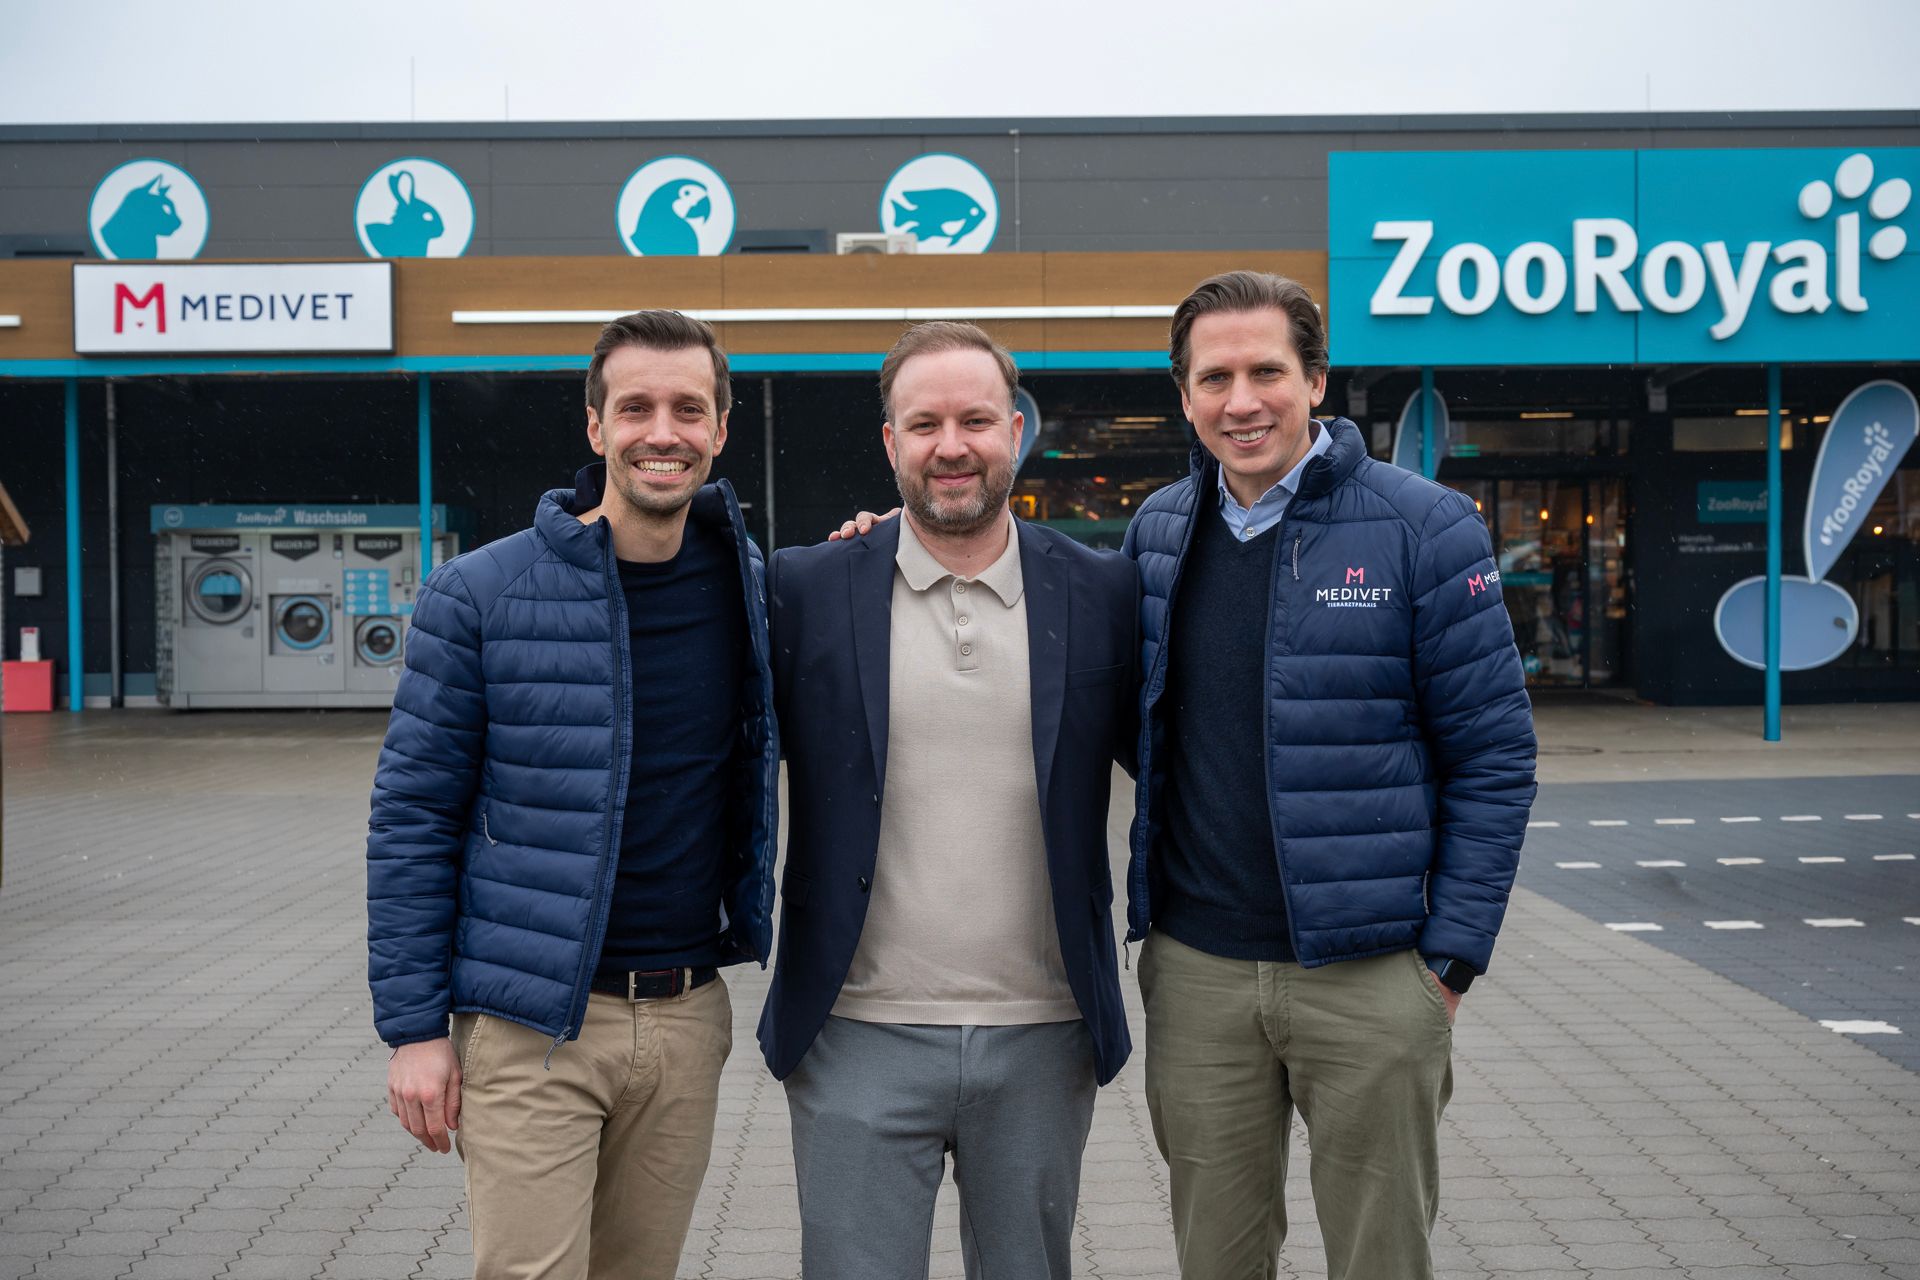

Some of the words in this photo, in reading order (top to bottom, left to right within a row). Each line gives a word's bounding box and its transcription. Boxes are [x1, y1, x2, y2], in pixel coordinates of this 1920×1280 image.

[1370, 211, 1869, 340] ZooRoyal
[115, 283, 166, 334] M
[181, 294, 353, 321] MEDIVET
[236, 510, 283, 526] ZooRoyal
[293, 509, 367, 524] Waschsalon
[1345, 567, 1364, 585] M
[1467, 573, 1487, 596] M
[1316, 588, 1392, 602] MEDIVET
